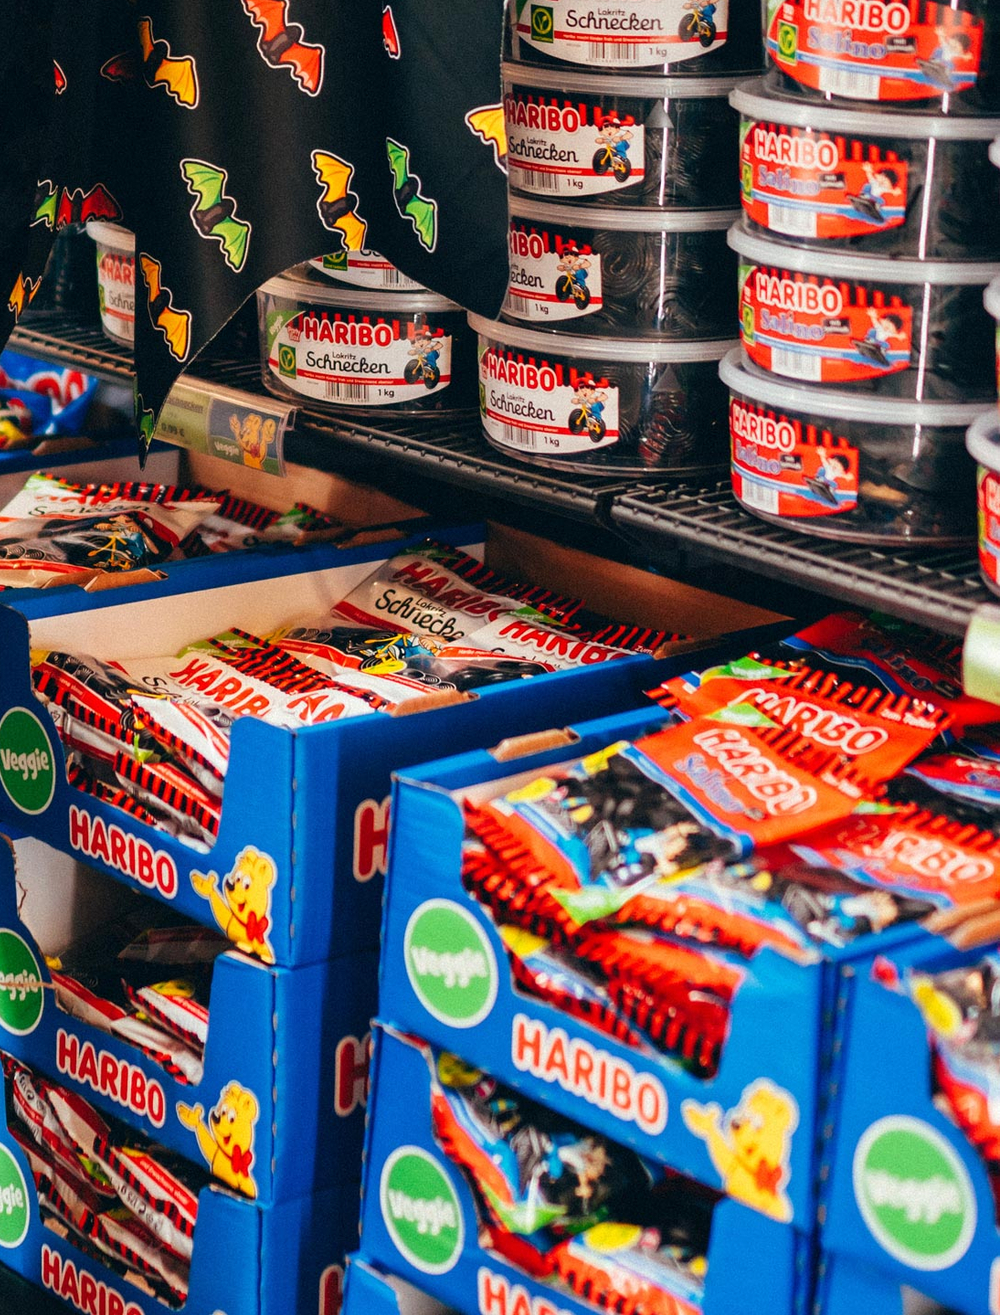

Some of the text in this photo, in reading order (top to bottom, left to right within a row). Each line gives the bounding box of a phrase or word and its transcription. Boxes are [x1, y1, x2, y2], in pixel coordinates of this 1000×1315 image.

[566, 9, 664, 31] Schnecken
[598, 7, 626, 17] Lakritz
[506, 99, 580, 133] HARIBO
[508, 135, 579, 163] Schnecken
[755, 129, 838, 171] HARIBO
[509, 232, 544, 260] IBO
[756, 273, 843, 316] HARIBO
[303, 317, 394, 348] HARIBO
[306, 350, 391, 374] Schnecken
[331, 351, 357, 361] Lakritz
[487, 354, 558, 392] HARIBO
[490, 389, 556, 422] Schnecken
[415, 597, 448, 617] Lakritz
[0, 748, 50, 781] Veggie
[69, 805, 178, 898] HARIBO
[56, 1029, 166, 1128] HARIBO
[513, 1014, 668, 1135] HARIBO
[42, 1244, 144, 1315] HARI
